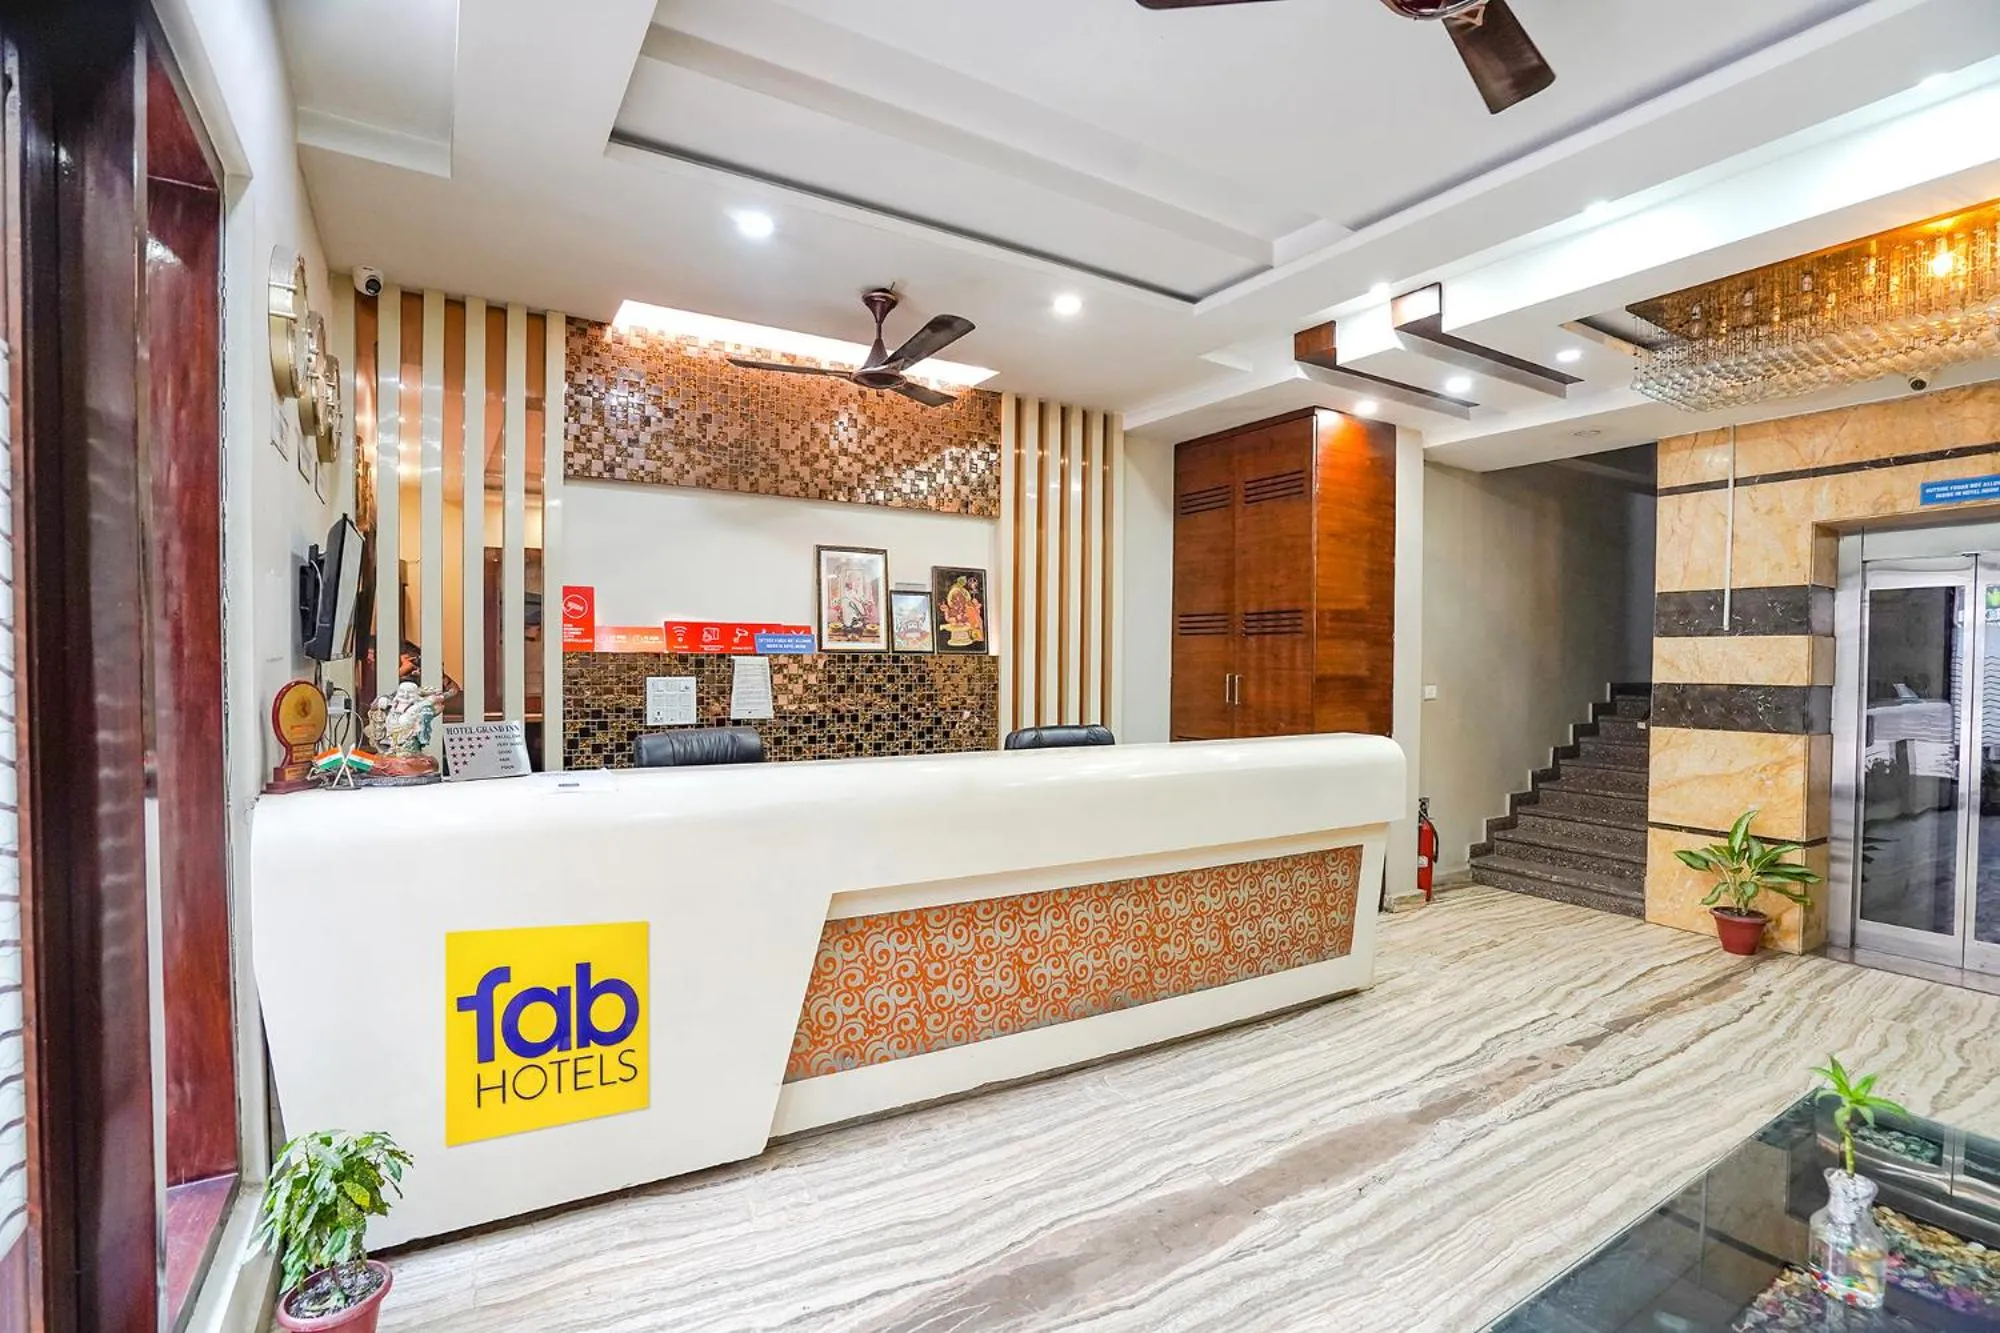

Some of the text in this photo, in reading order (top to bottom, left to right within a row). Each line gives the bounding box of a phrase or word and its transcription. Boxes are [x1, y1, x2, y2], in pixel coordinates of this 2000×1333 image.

[445, 724, 520, 735] HOTEL GRAND INN
[456, 961, 640, 1064] fab
[476, 1048, 639, 1109] HOTELS
